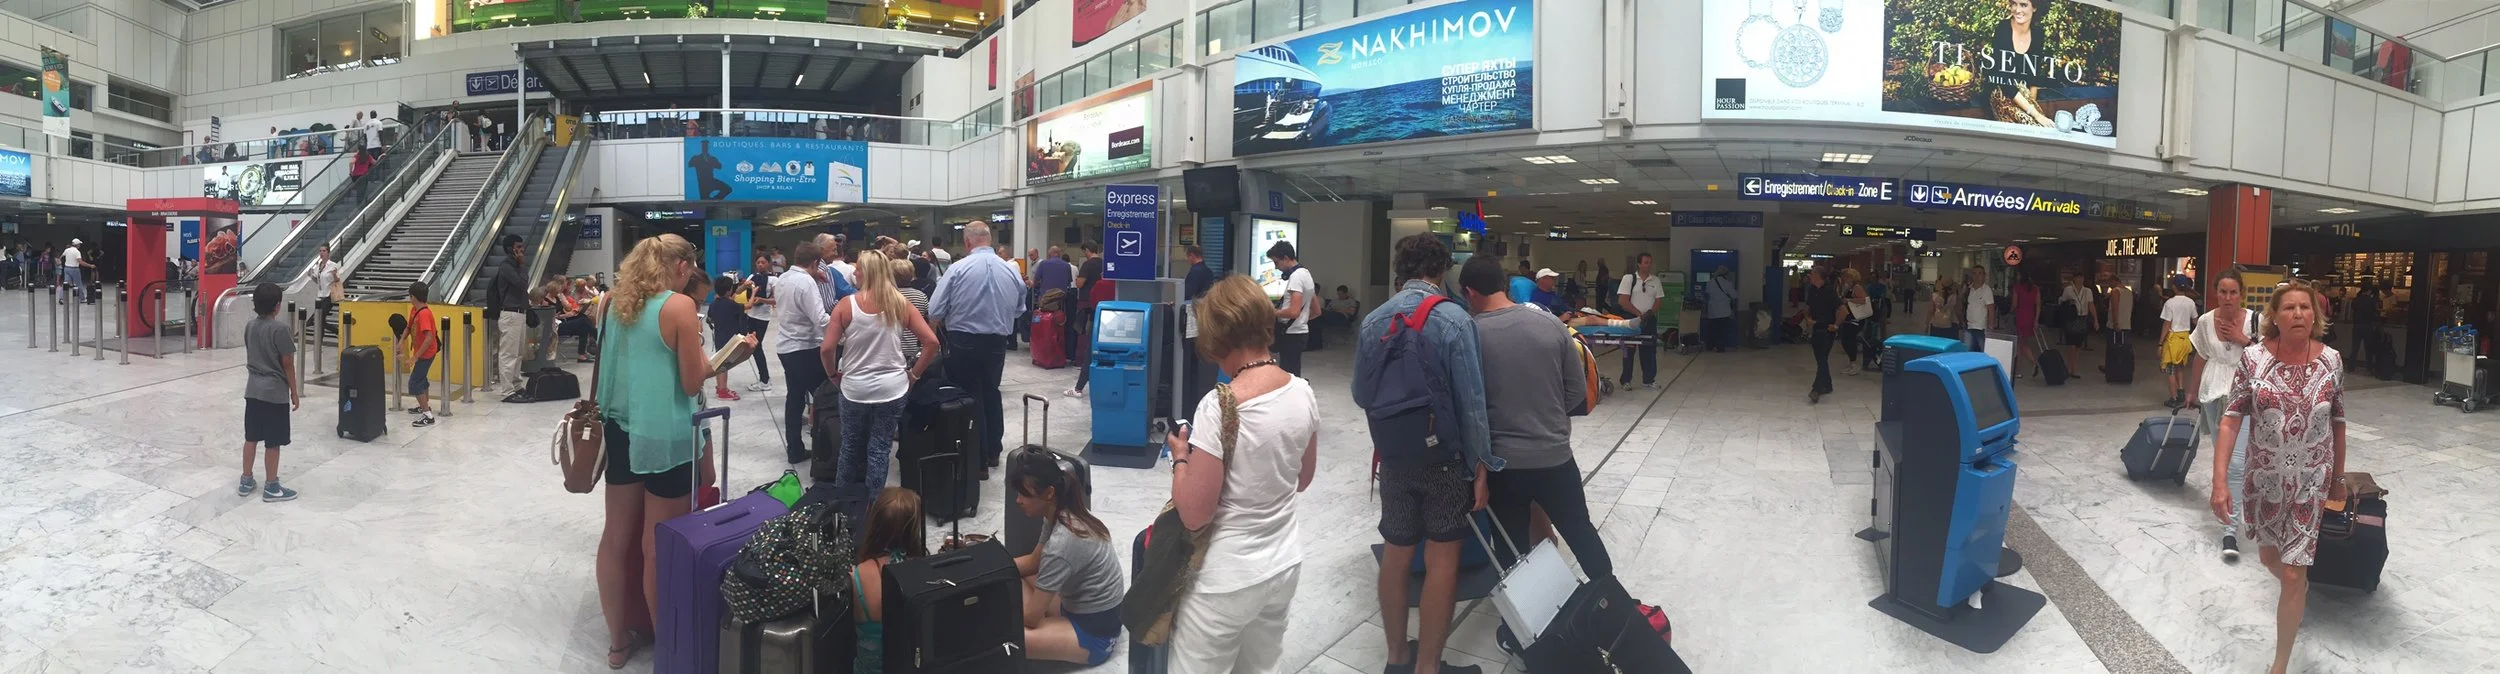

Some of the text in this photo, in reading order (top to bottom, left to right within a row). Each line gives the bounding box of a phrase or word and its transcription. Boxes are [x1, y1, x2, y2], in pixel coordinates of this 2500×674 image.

[1351, 7, 1517, 60] NAKHIMOV
[1351, 58, 1383, 69] MONACO
[1442, 56, 1516, 76] СУПЕР ЯХТЫ
[1932, 40, 2083, 83] TI SENTO
[1442, 69, 1516, 86] СТРОИТЕЛЬСТВО
[1988, 75, 2027, 86] MILANO
[1442, 79, 1516, 95] КУПЛЯ-ПРОДАЖА
[1442, 88, 1516, 105] МЕНЕДЖМЕНТ
[1459, 101, 1497, 113] ЧАРТЕР
[1111, 138, 1140, 149] Bordeaux.com
[1904, 135, 1933, 143] JCDecaux
[805, 143, 864, 151] RESTAURANTS
[734, 173, 817, 184] Shopping Bien-Être
[1858, 182, 1878, 198] Zone
[1880, 182, 1893, 200] E
[1107, 191, 1155, 207] express
[1107, 209, 1155, 219] Enregistrement
[1107, 221, 1131, 229] Check-in
[1904, 228, 1911, 237] F
[2105, 239, 2118, 256] JOE
[2122, 238, 2135, 255] THE
[2136, 236, 2159, 255] JUICE
